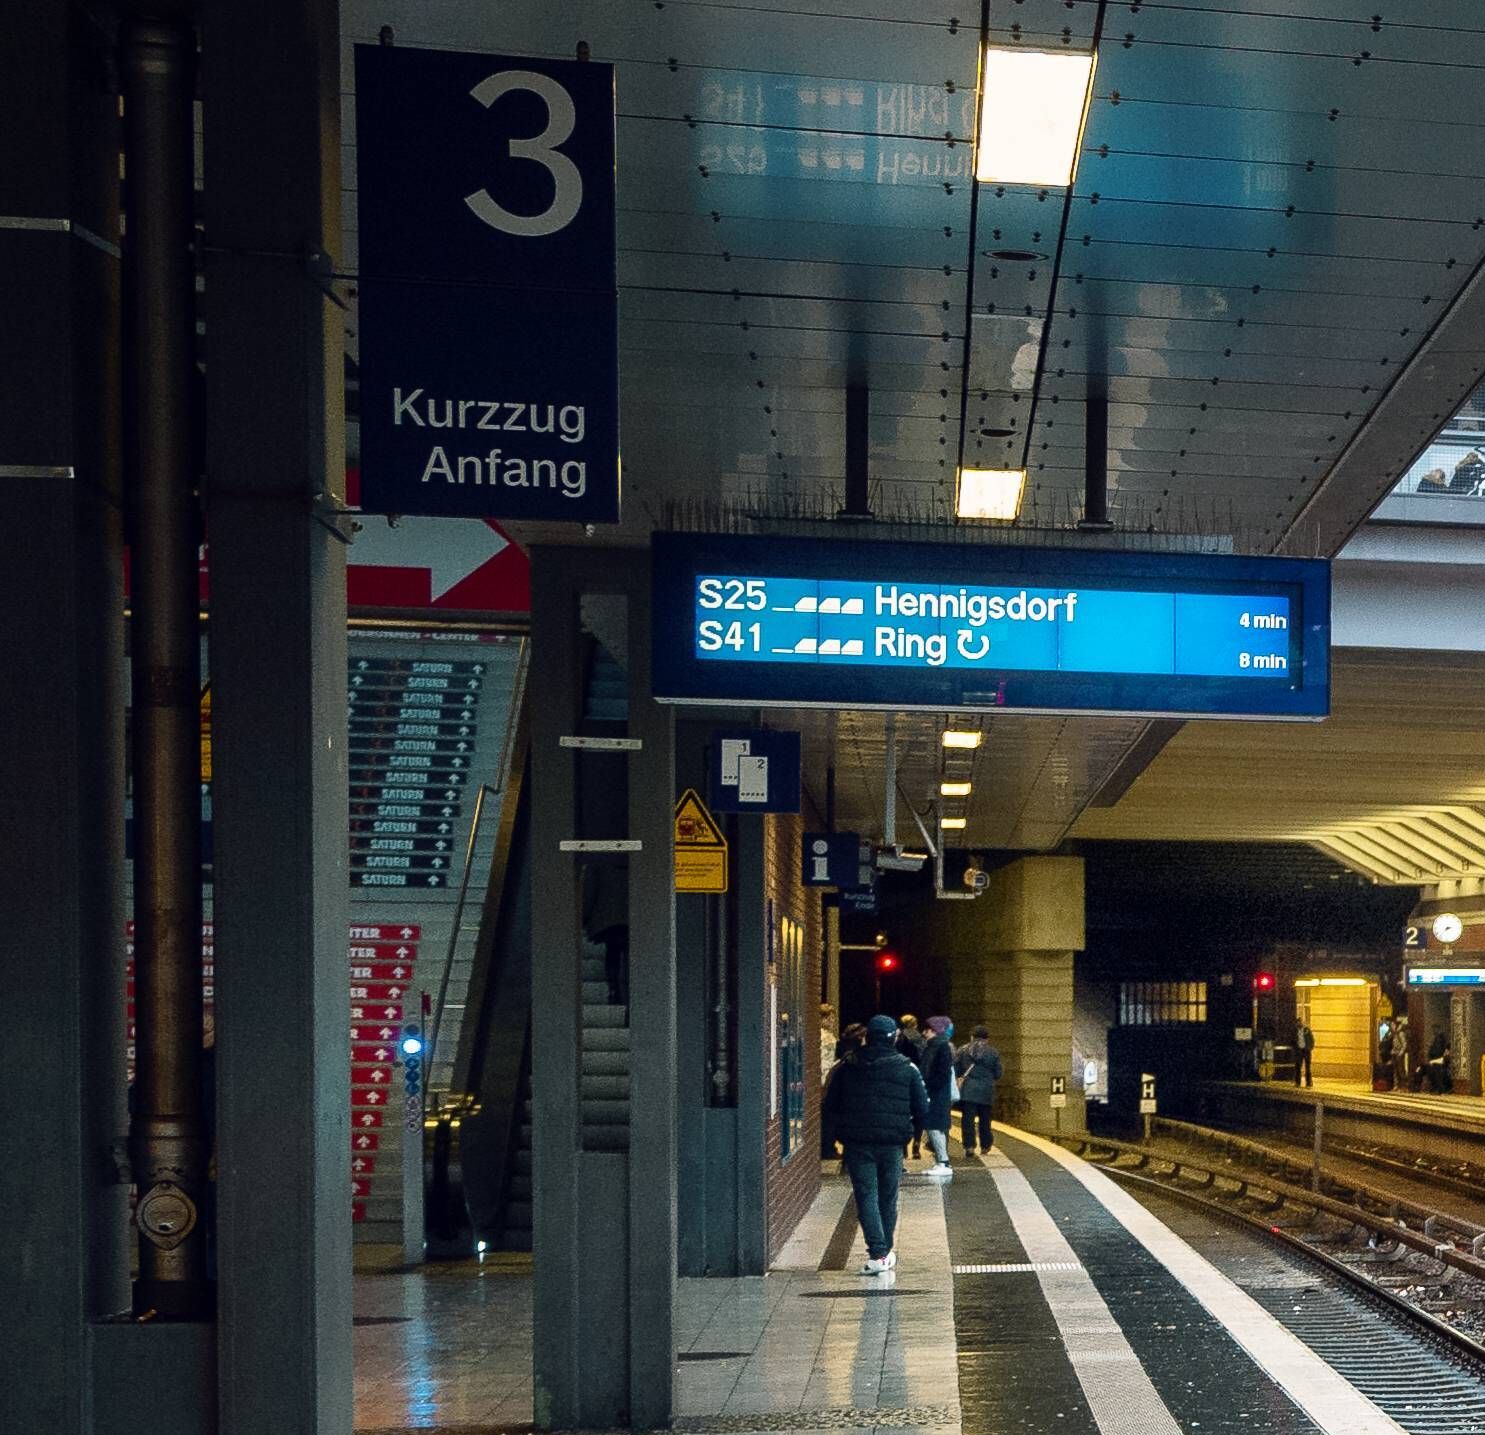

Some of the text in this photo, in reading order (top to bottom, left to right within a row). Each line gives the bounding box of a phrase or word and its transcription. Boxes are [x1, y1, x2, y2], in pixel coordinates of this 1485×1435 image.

[464, 70, 583, 237] 3
[393, 386, 586, 444] Kurzzug
[421, 446, 587, 499] Anfang
[699, 579, 1288, 629] S25 Hennigsdorf 4 min
[699, 621, 1288, 669] S41 Ring 8 min
[1406, 928, 1418, 945] 2
[1052, 1079, 1064, 1092] H
[1143, 1083, 1154, 1098] H
